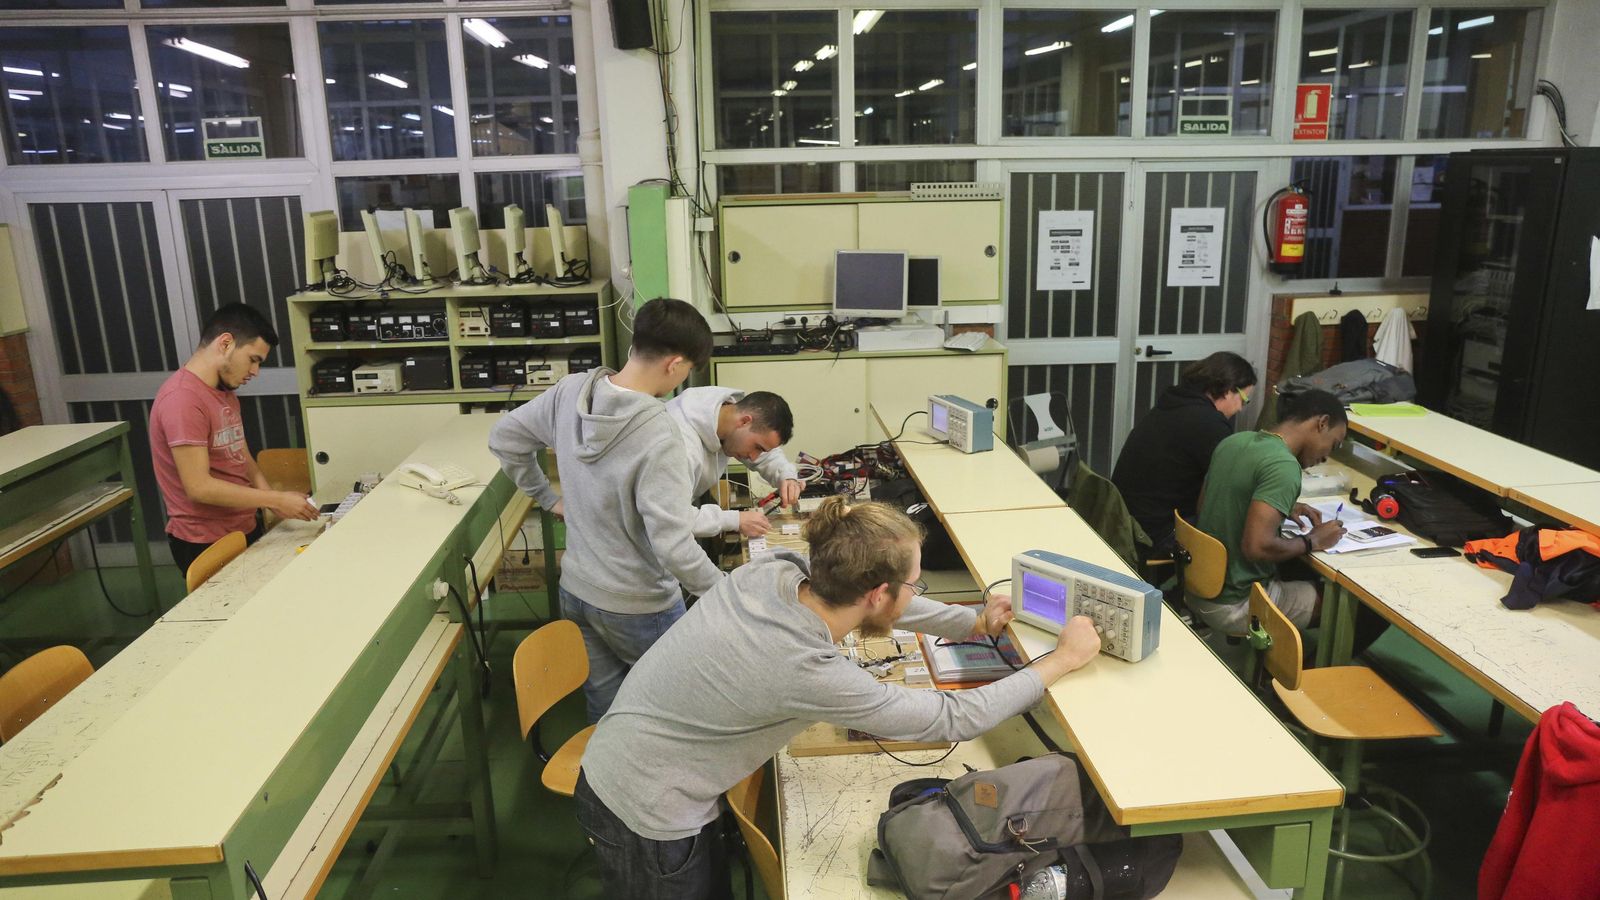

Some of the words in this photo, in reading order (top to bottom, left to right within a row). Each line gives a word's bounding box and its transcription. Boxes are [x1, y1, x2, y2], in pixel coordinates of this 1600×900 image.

[1183, 123, 1227, 131] SALIDA
[1294, 128, 1325, 136] EXTINTOR
[212, 145, 259, 154] SALIDA
